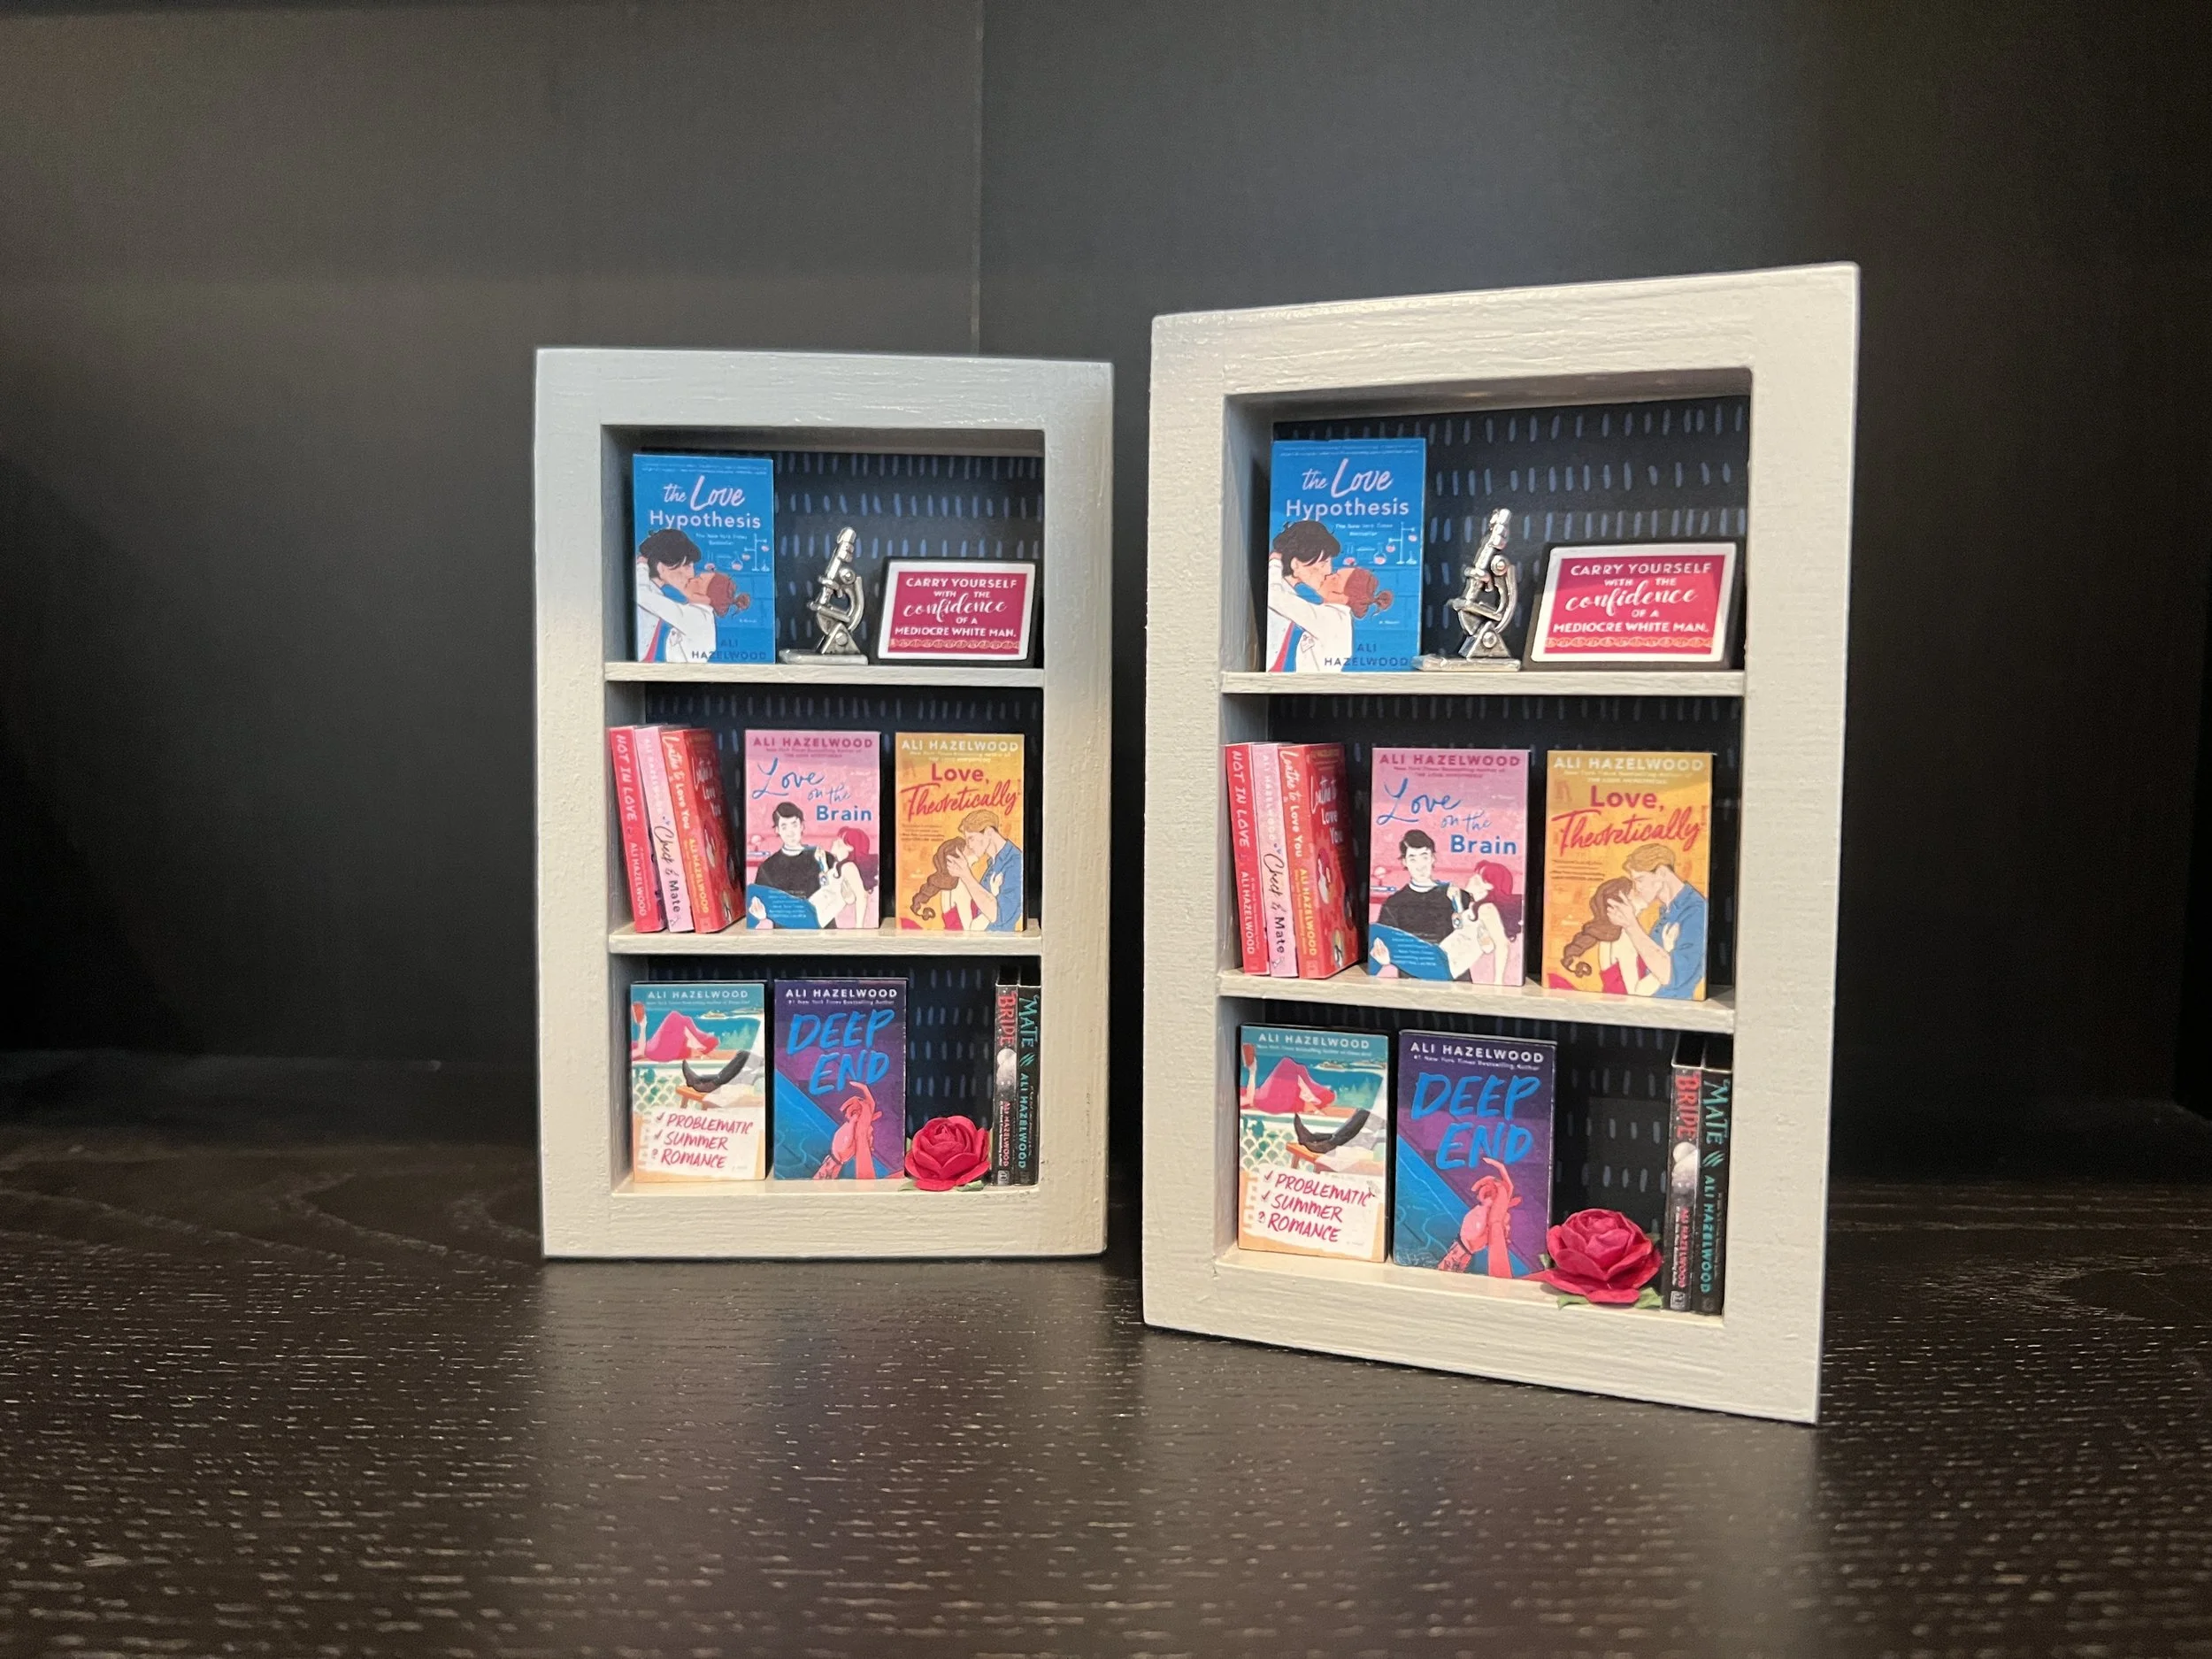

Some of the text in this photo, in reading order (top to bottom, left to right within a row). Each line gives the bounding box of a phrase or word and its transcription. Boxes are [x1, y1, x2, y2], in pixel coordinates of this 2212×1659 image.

[1302, 457, 1394, 498] the Love
[664, 475, 745, 511] the Love
[649, 510, 761, 530] Hypothesis
[1286, 497, 1409, 521] Hypothesis
[1571, 563, 1712, 575] CARRY YOURSELF
[906, 578, 1018, 588] CARRY YOURSELF
[902, 592, 1008, 623] confidence
[1565, 580, 1698, 617] confidence
[895, 626, 1017, 637] MEDIOCRE WHITE MAN.
[1553, 622, 1622, 633] MEDIOCRE
[1625, 622, 1670, 632] WHITE
[691, 649, 766, 660] HAZELWOOD
[720, 638, 738, 648] ALI
[1357, 643, 1377, 652] ALI
[1325, 657, 1409, 667] HAZELWOOD
[753, 737, 873, 748] ALI HAZELWOOD
[902, 740, 1018, 752] ALI HAZELWOOD
[1379, 755, 1520, 766] ALI HAZELWOOD
[1554, 757, 1703, 771] ALI HAZELWOOD
[616, 734, 637, 822] NOT IN LOVE
[751, 757, 825, 800] Love
[931, 763, 990, 784] Love,
[675, 784, 687, 805] Love
[807, 785, 850, 803] on the
[900, 780, 1018, 823] Theoretically
[1232, 750, 1249, 848] NOT IN LOVE
[1376, 778, 1461, 825] Love
[1590, 785, 1664, 811] Love,
[680, 806, 691, 830] You
[816, 805, 872, 822] Brain
[1290, 804, 1301, 832] Love
[1440, 810, 1492, 833] on the
[1551, 806, 1701, 856] Theoretically
[629, 841, 639, 857] ALI
[688, 839, 697, 854] ALI
[1293, 833, 1302, 858] You
[1450, 834, 1517, 855] Brain
[654, 825, 675, 865] Check
[668, 879, 681, 913] Mate
[1300, 869, 1310, 885] ALI
[630, 858, 648, 917] HAZELWOOD
[692, 855, 709, 913] HAZELWOOD
[1263, 852, 1285, 896] Check
[1274, 917, 1285, 954] Mate
[1242, 889, 1255, 955] HAZELWOOD
[1302, 887, 1317, 956] HAZELWOOD
[672, 990, 749, 999] HAZELWOOD
[786, 988, 897, 998] ALI HAZELWOOD
[998, 990, 1018, 1047] BRIDE
[1018, 995, 1040, 1048] MATE
[787, 1009, 895, 1056] DEEP
[1258, 1033, 1370, 1049] ALI HAZELWOOD
[1410, 1042, 1544, 1064] ALI HAZELWOOD
[809, 1049, 890, 1096] END
[1411, 1071, 1540, 1121] DEEP
[1675, 1071, 1701, 1139] BRIDE
[666, 1113, 754, 1135] PROBLEMATIC
[1703, 1079, 1728, 1145] MATE
[664, 1131, 728, 1150] SUMMER
[1018, 1095, 1028, 1169] HAZELWOOD
[661, 1148, 727, 1169] ROMANCE
[1435, 1122, 1533, 1171] END
[1275, 1173, 1371, 1207] PROBLEMATIC
[1271, 1194, 1342, 1223] SUMMER
[1268, 1212, 1341, 1242] ROMANCE
[1701, 1175, 1716, 1293] ALI HAZELWOOD
